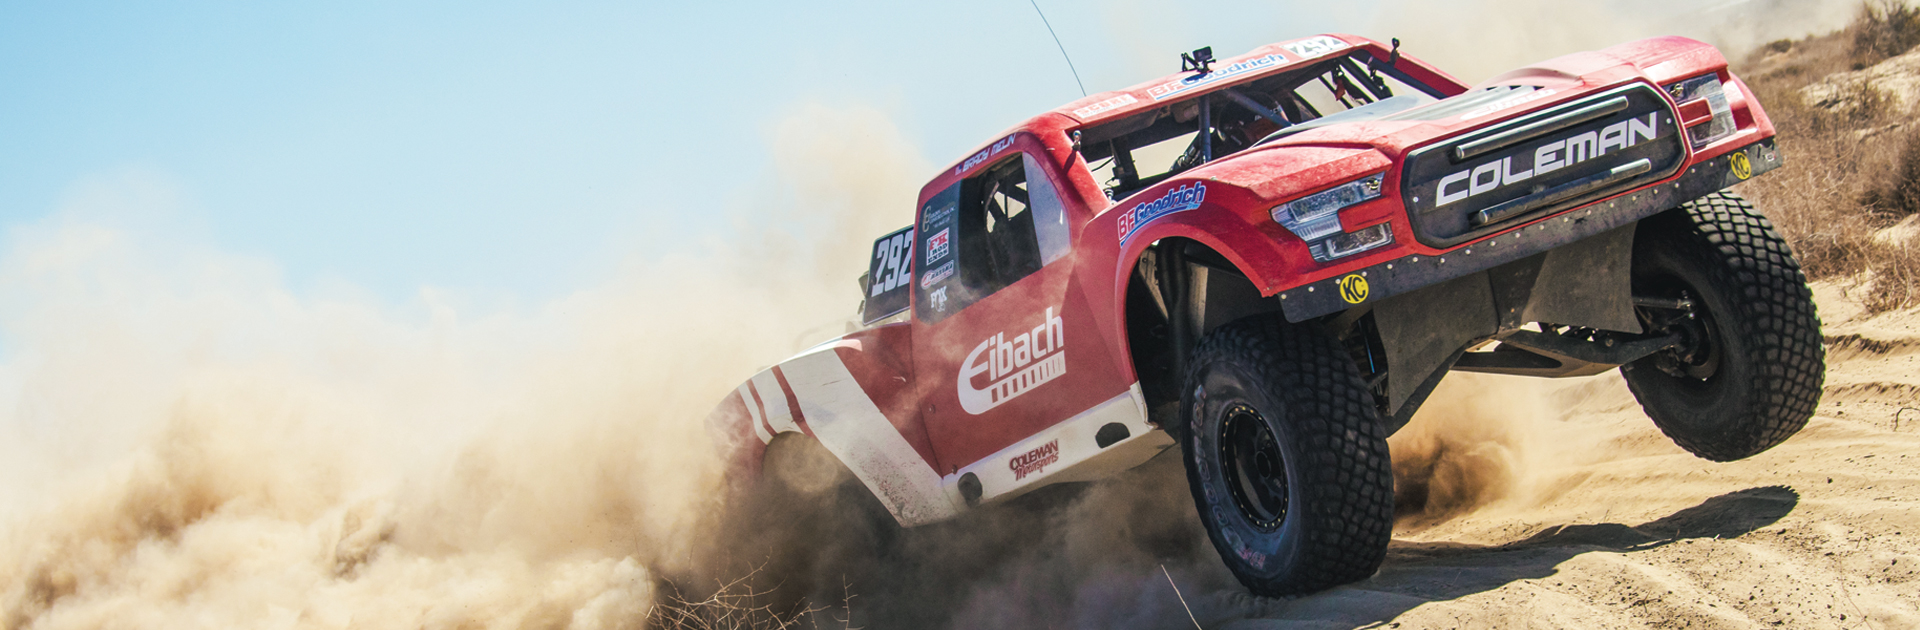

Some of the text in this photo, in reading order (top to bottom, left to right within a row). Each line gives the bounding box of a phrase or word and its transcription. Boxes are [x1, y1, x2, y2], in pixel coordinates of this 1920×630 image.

[1288, 36, 1348, 58] 292
[1436, 111, 1658, 208] COLEMAN
[1732, 154, 1750, 178] KC
[1116, 180, 1207, 240] BFGoodrich
[928, 249, 948, 264] ENDS
[932, 243, 948, 255] ROD
[871, 229, 913, 297] 292
[930, 286, 948, 310] FOX
[1342, 276, 1367, 302] KC
[957, 306, 1064, 415] Eibach
[1009, 439, 1060, 471] COLEMAN
[1014, 452, 1060, 481] Motorsports
